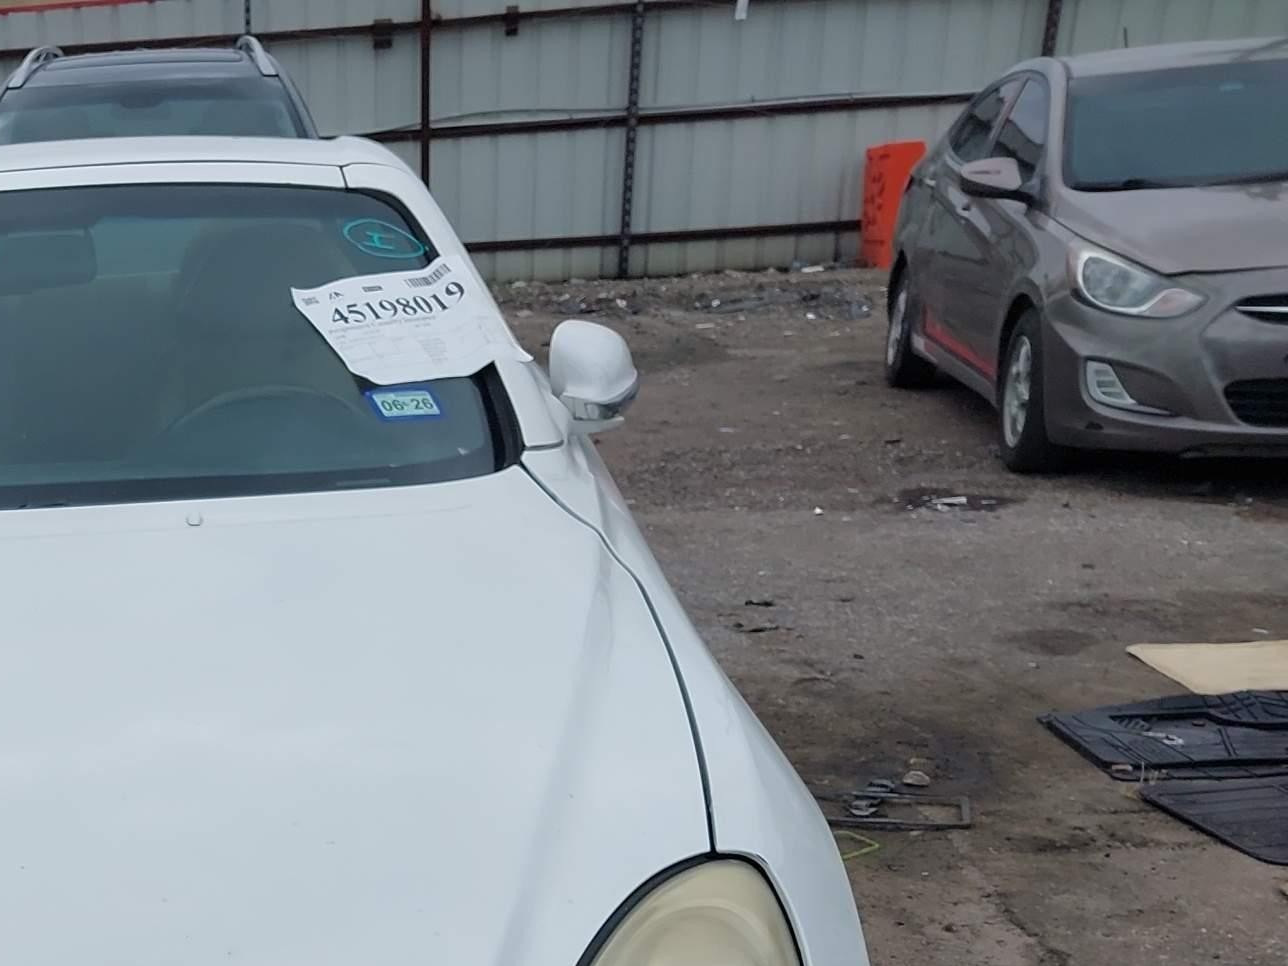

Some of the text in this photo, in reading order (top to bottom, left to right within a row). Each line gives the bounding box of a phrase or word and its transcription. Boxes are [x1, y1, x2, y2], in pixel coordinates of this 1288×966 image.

[331, 282, 465, 324] 45198019
[380, 398, 434, 412] 06 26
